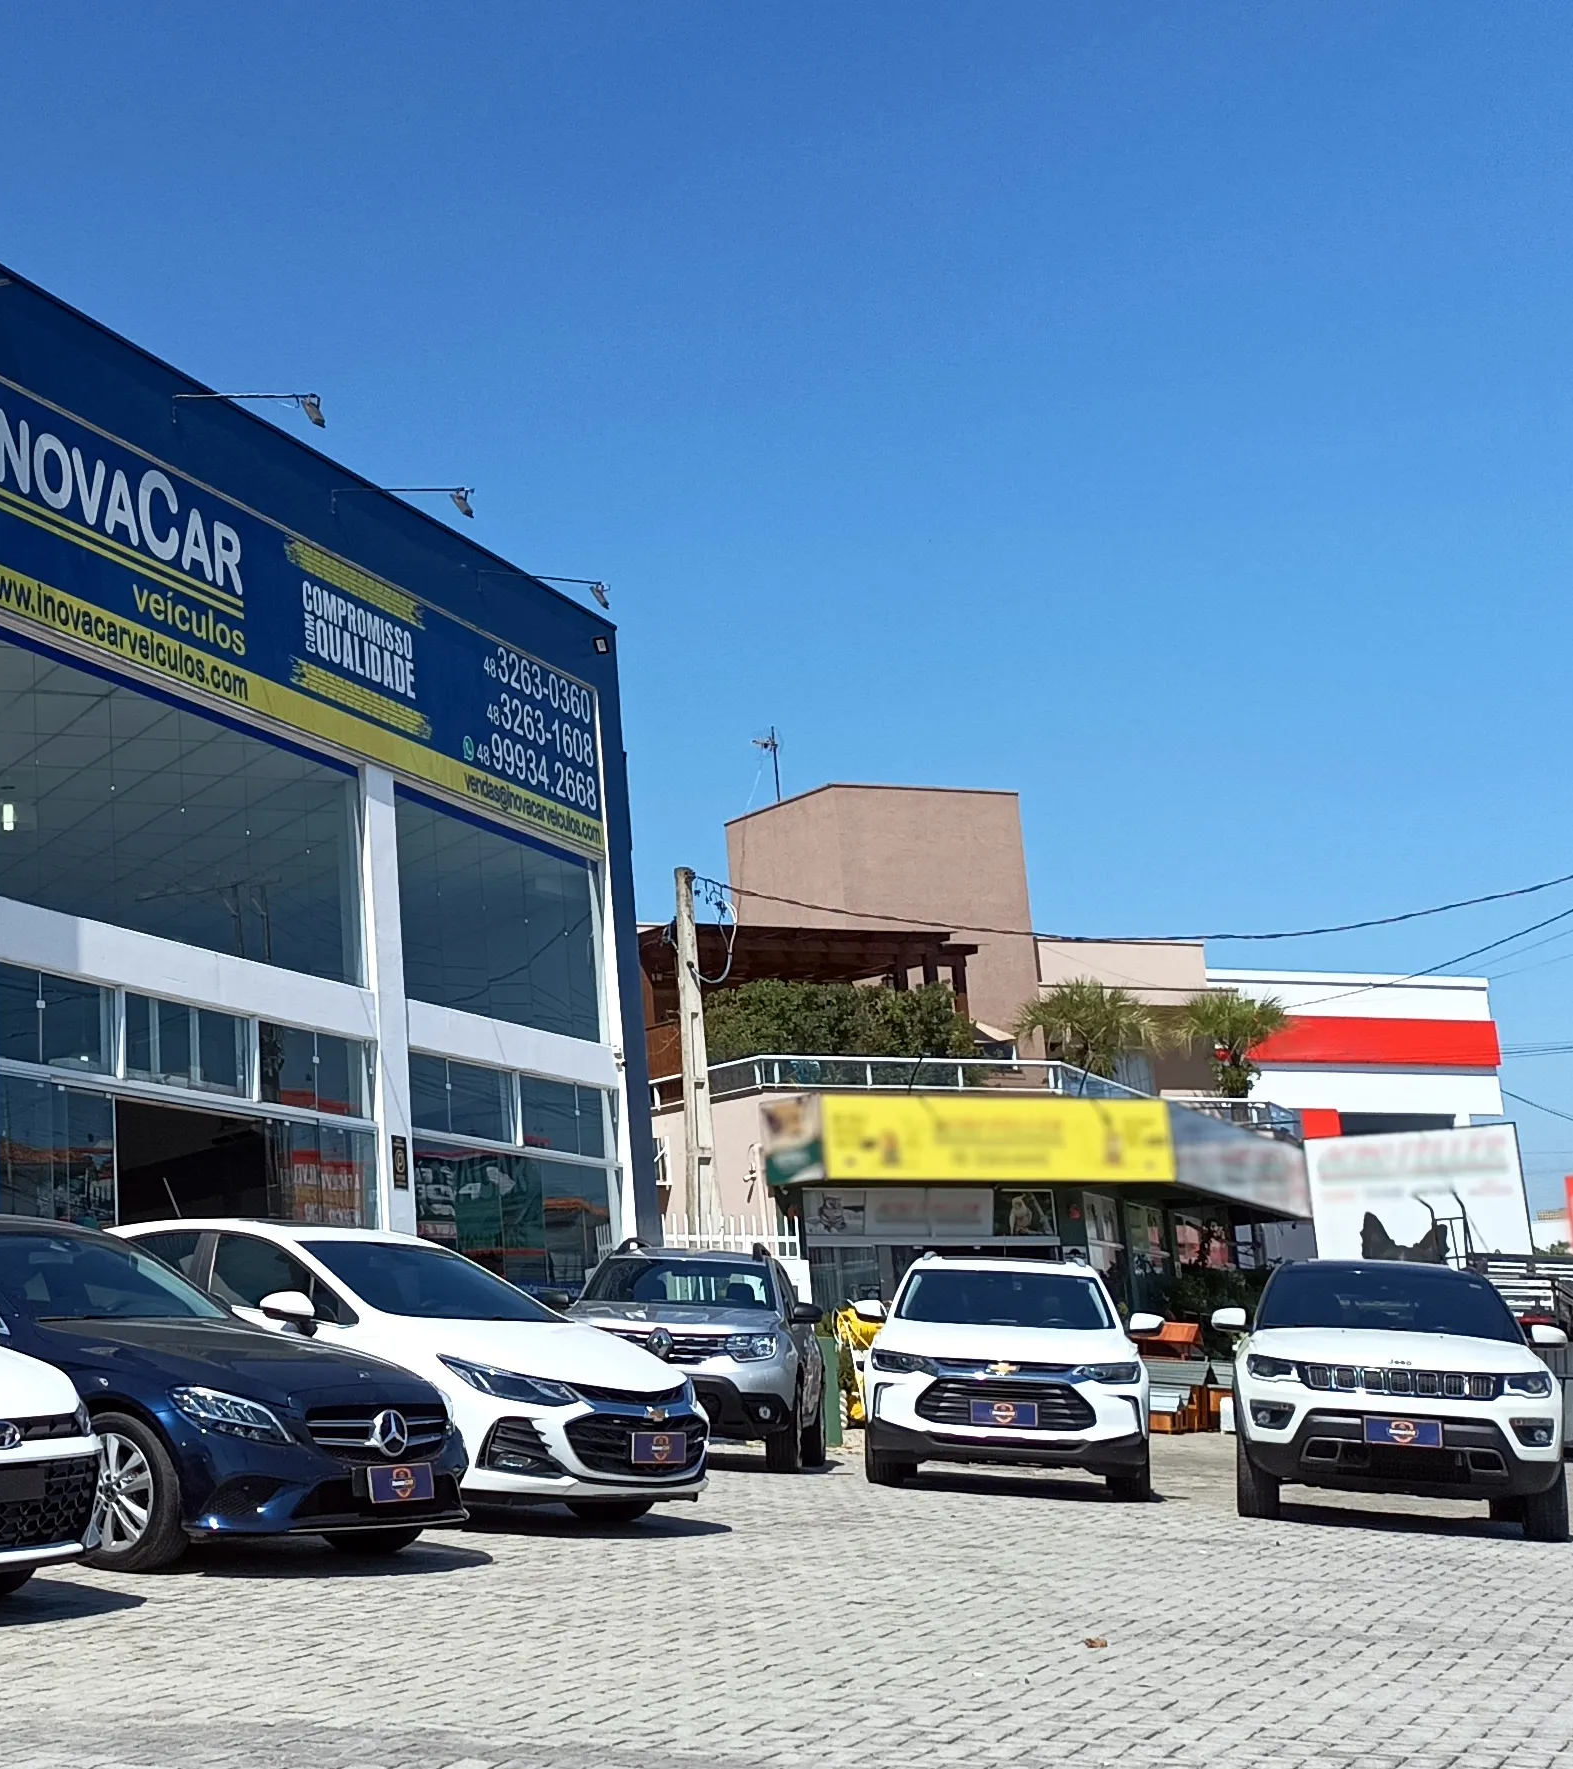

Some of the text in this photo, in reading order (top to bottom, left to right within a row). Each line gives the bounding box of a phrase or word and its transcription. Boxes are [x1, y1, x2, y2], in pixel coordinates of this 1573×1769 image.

[132, 583, 246, 656] veículos
[302, 580, 413, 660] COMPROMISSO
[304, 613, 416, 700] COM QUALIDADE
[483, 646, 591, 724] 48 3263-0360
[487, 693, 594, 768] 48 3263-1608
[476, 732, 597, 811] 48 99934.2668
